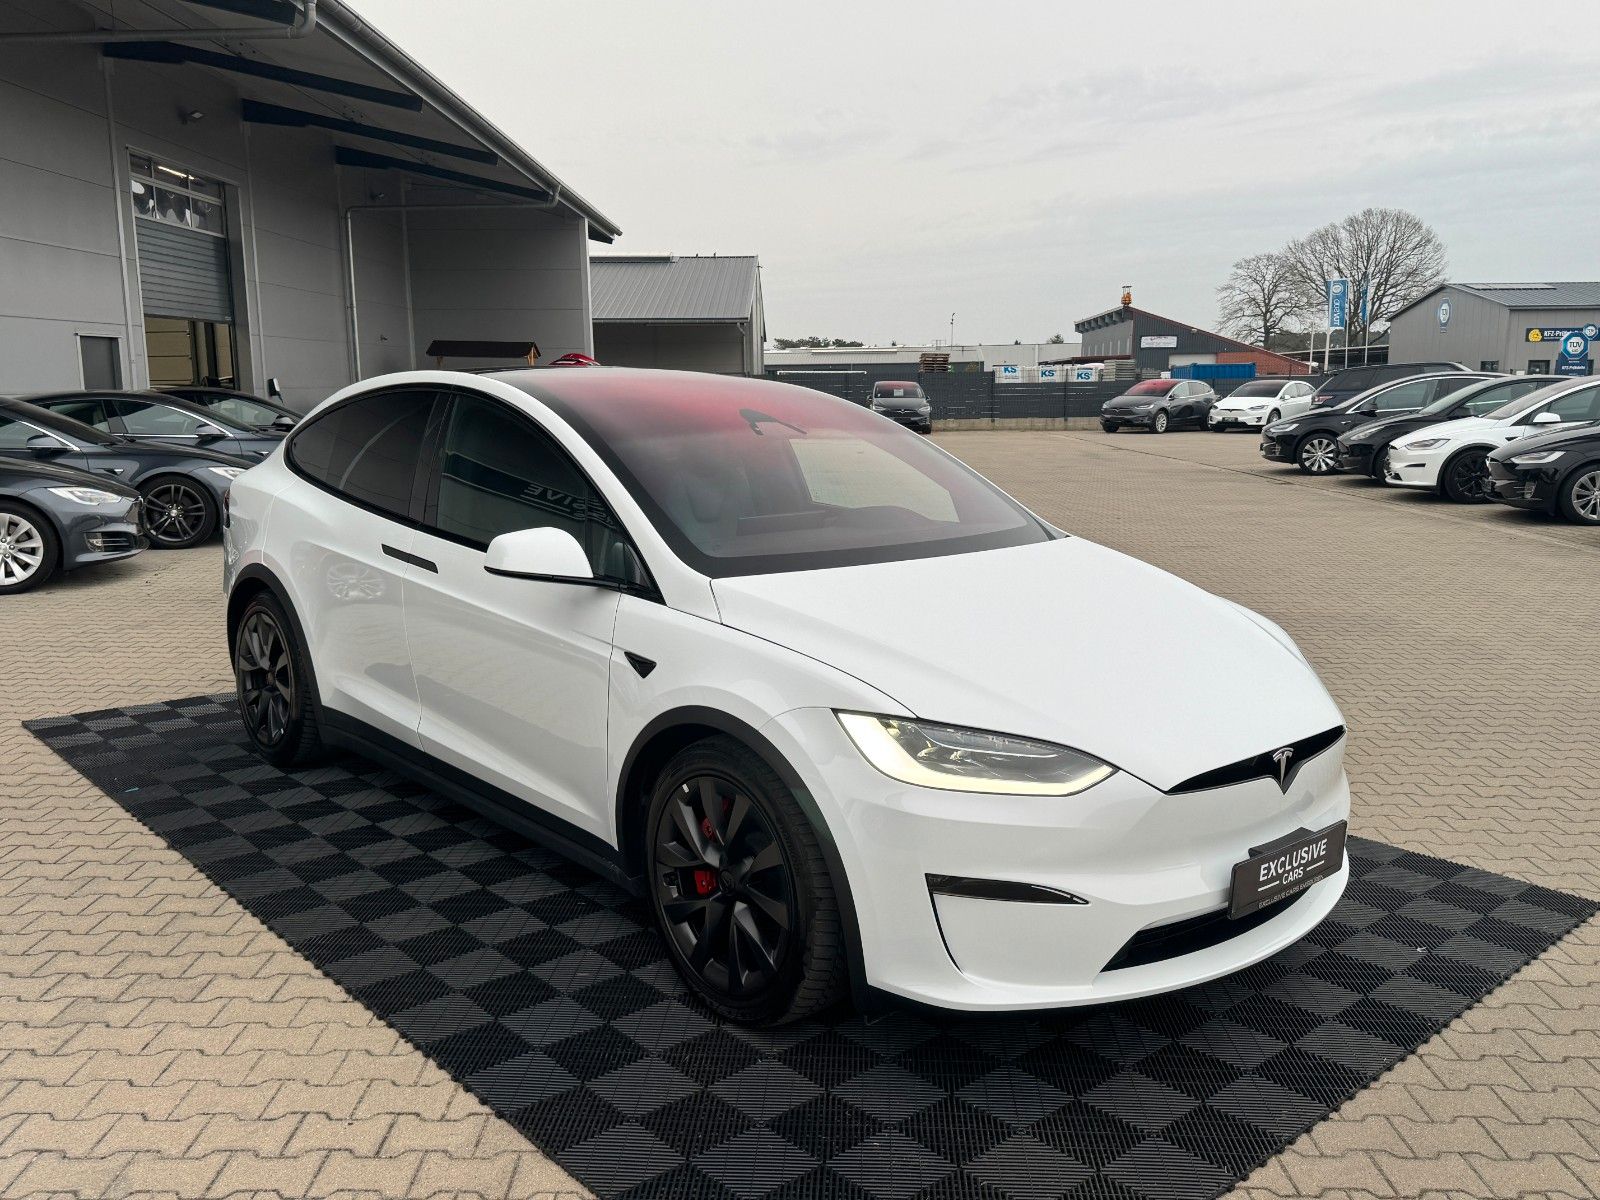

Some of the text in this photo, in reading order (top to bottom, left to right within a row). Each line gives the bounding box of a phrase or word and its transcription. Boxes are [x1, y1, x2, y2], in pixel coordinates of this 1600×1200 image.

[1041, 370, 1055, 378] KS
[1077, 372, 1091, 380] KS
[1260, 838, 1328, 881] EXCLUSIVE
[1282, 867, 1304, 884] CARS
